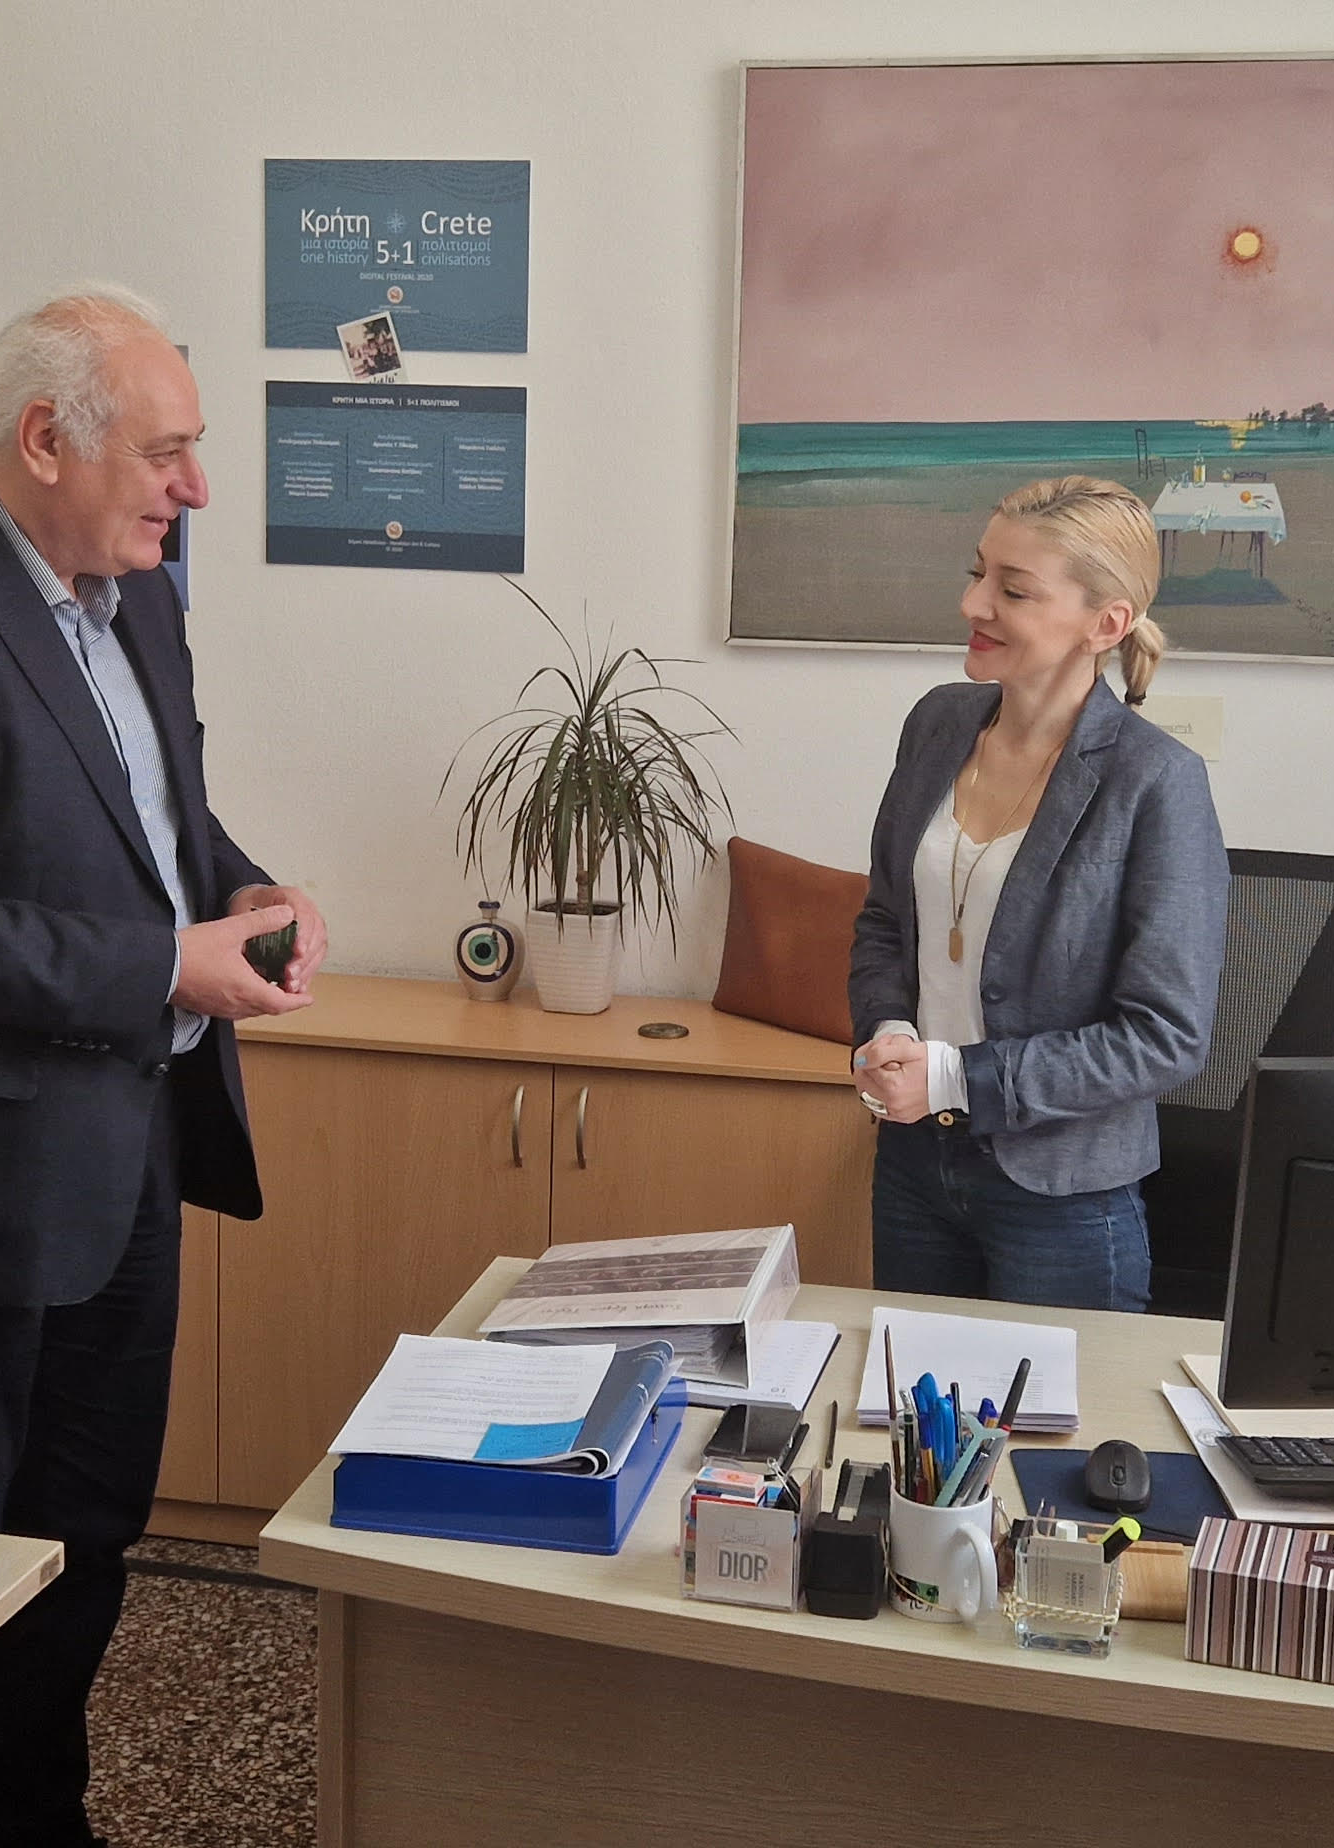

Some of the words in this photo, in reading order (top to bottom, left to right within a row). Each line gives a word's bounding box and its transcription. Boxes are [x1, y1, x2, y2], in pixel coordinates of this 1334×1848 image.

[301, 207, 370, 239] Κρήτη
[421, 210, 492, 236] Crete
[324, 236, 369, 252] ιστορία
[376, 240, 415, 265] 5+1
[421, 237, 492, 254] πολιτισμοί
[301, 253, 325, 264] one
[327, 251, 369, 268] history
[421, 252, 492, 267] civilisations
[718, 1549, 768, 1582] DIOR
